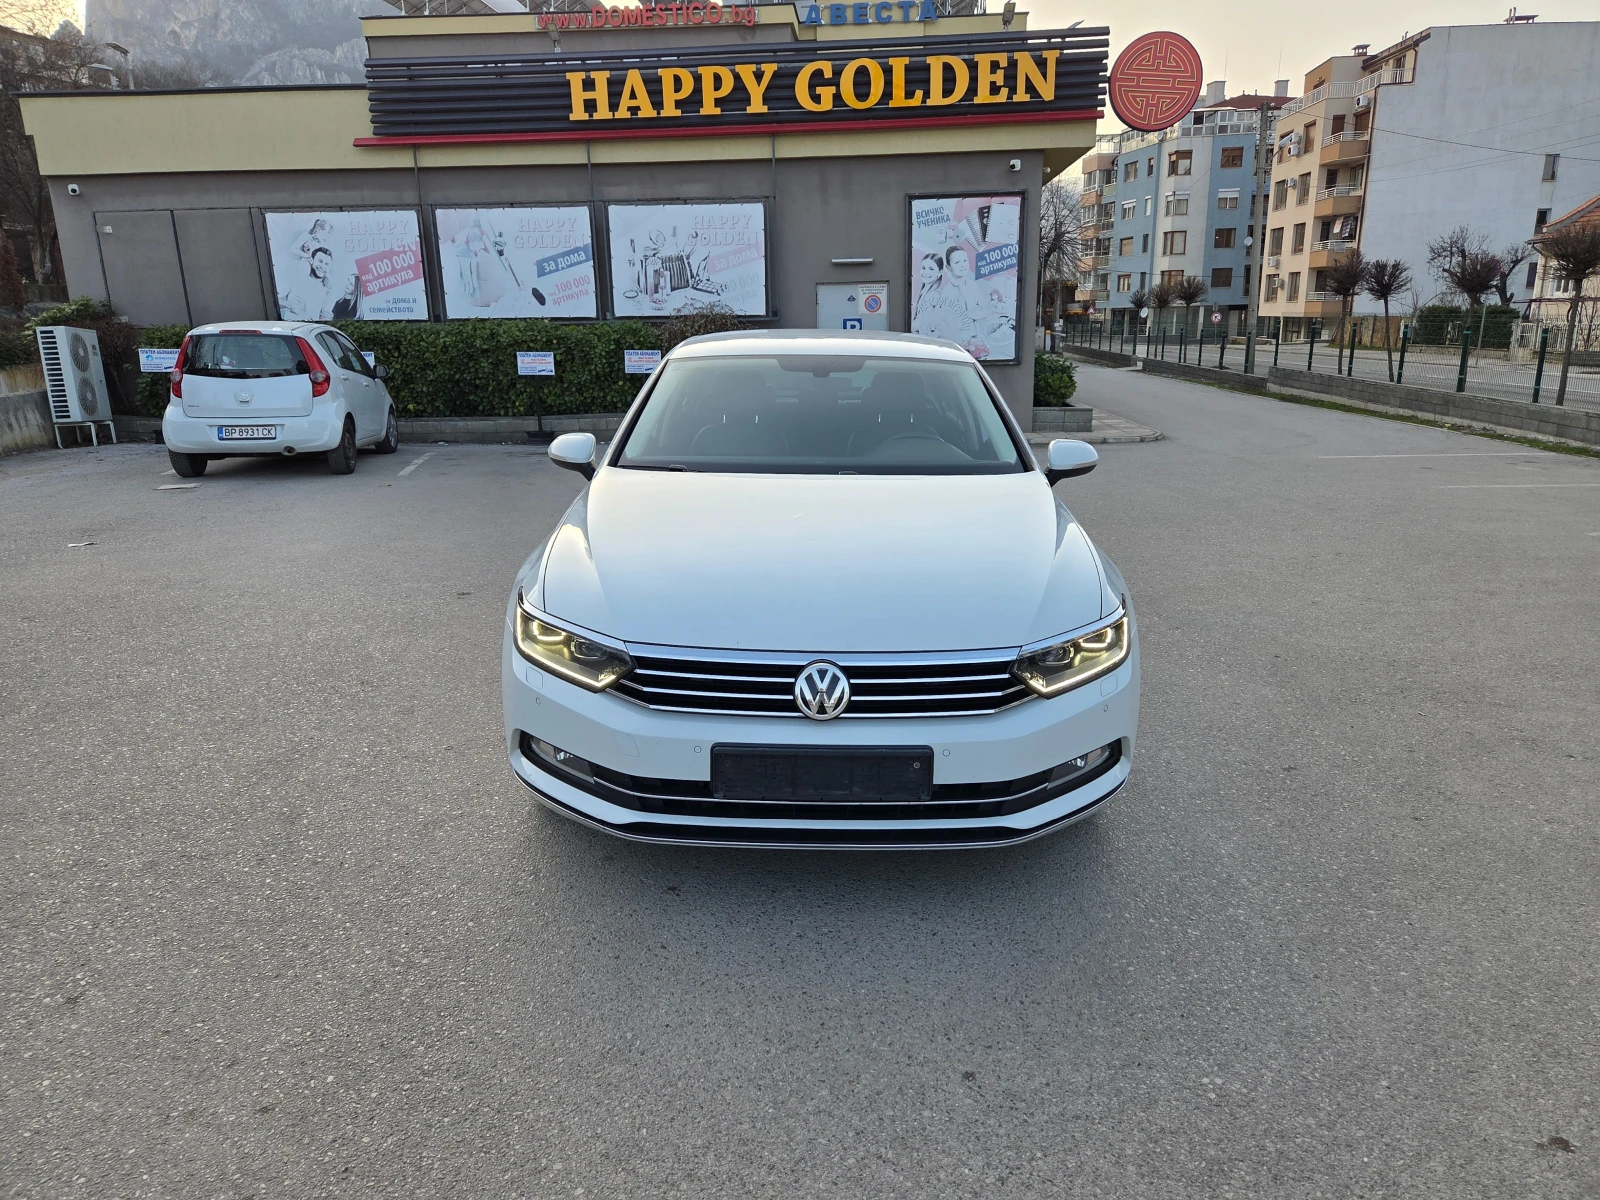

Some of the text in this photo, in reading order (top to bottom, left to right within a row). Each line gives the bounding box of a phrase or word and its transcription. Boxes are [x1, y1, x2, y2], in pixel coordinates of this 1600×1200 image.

[538, 2, 756, 28] www.DOMESTICO.bg
[804, 0, 938, 25] АВЕСТА
[565, 50, 1060, 121] HAPPY GOLDEN
[691, 215, 752, 230] HAPPY
[915, 206, 945, 220] ВСИЧКО
[916, 213, 951, 229] УЧЕНИКА
[347, 220, 409, 236] HAPPY
[518, 218, 578, 233] HAPPY
[344, 237, 417, 253] GOLDEN
[514, 234, 585, 249] GOLDEN
[687, 231, 759, 247] GOLDEN
[542, 250, 587, 273] за дома
[713, 248, 758, 271] за дома
[984, 249, 1001, 263] 100
[1002, 243, 1019, 258] 000
[361, 251, 415, 282] над 100 000
[980, 256, 1017, 275] артикула
[366, 269, 414, 294] артикула
[554, 280, 572, 294] 100
[573, 274, 591, 288] 000
[392, 297, 411, 305] дома
[551, 287, 590, 306] артикула
[369, 304, 414, 314] семейството
[224, 428, 237, 437] BP
[238, 428, 260, 437] 8931
[261, 428, 274, 437] CK
[796, 664, 849, 719] VW
